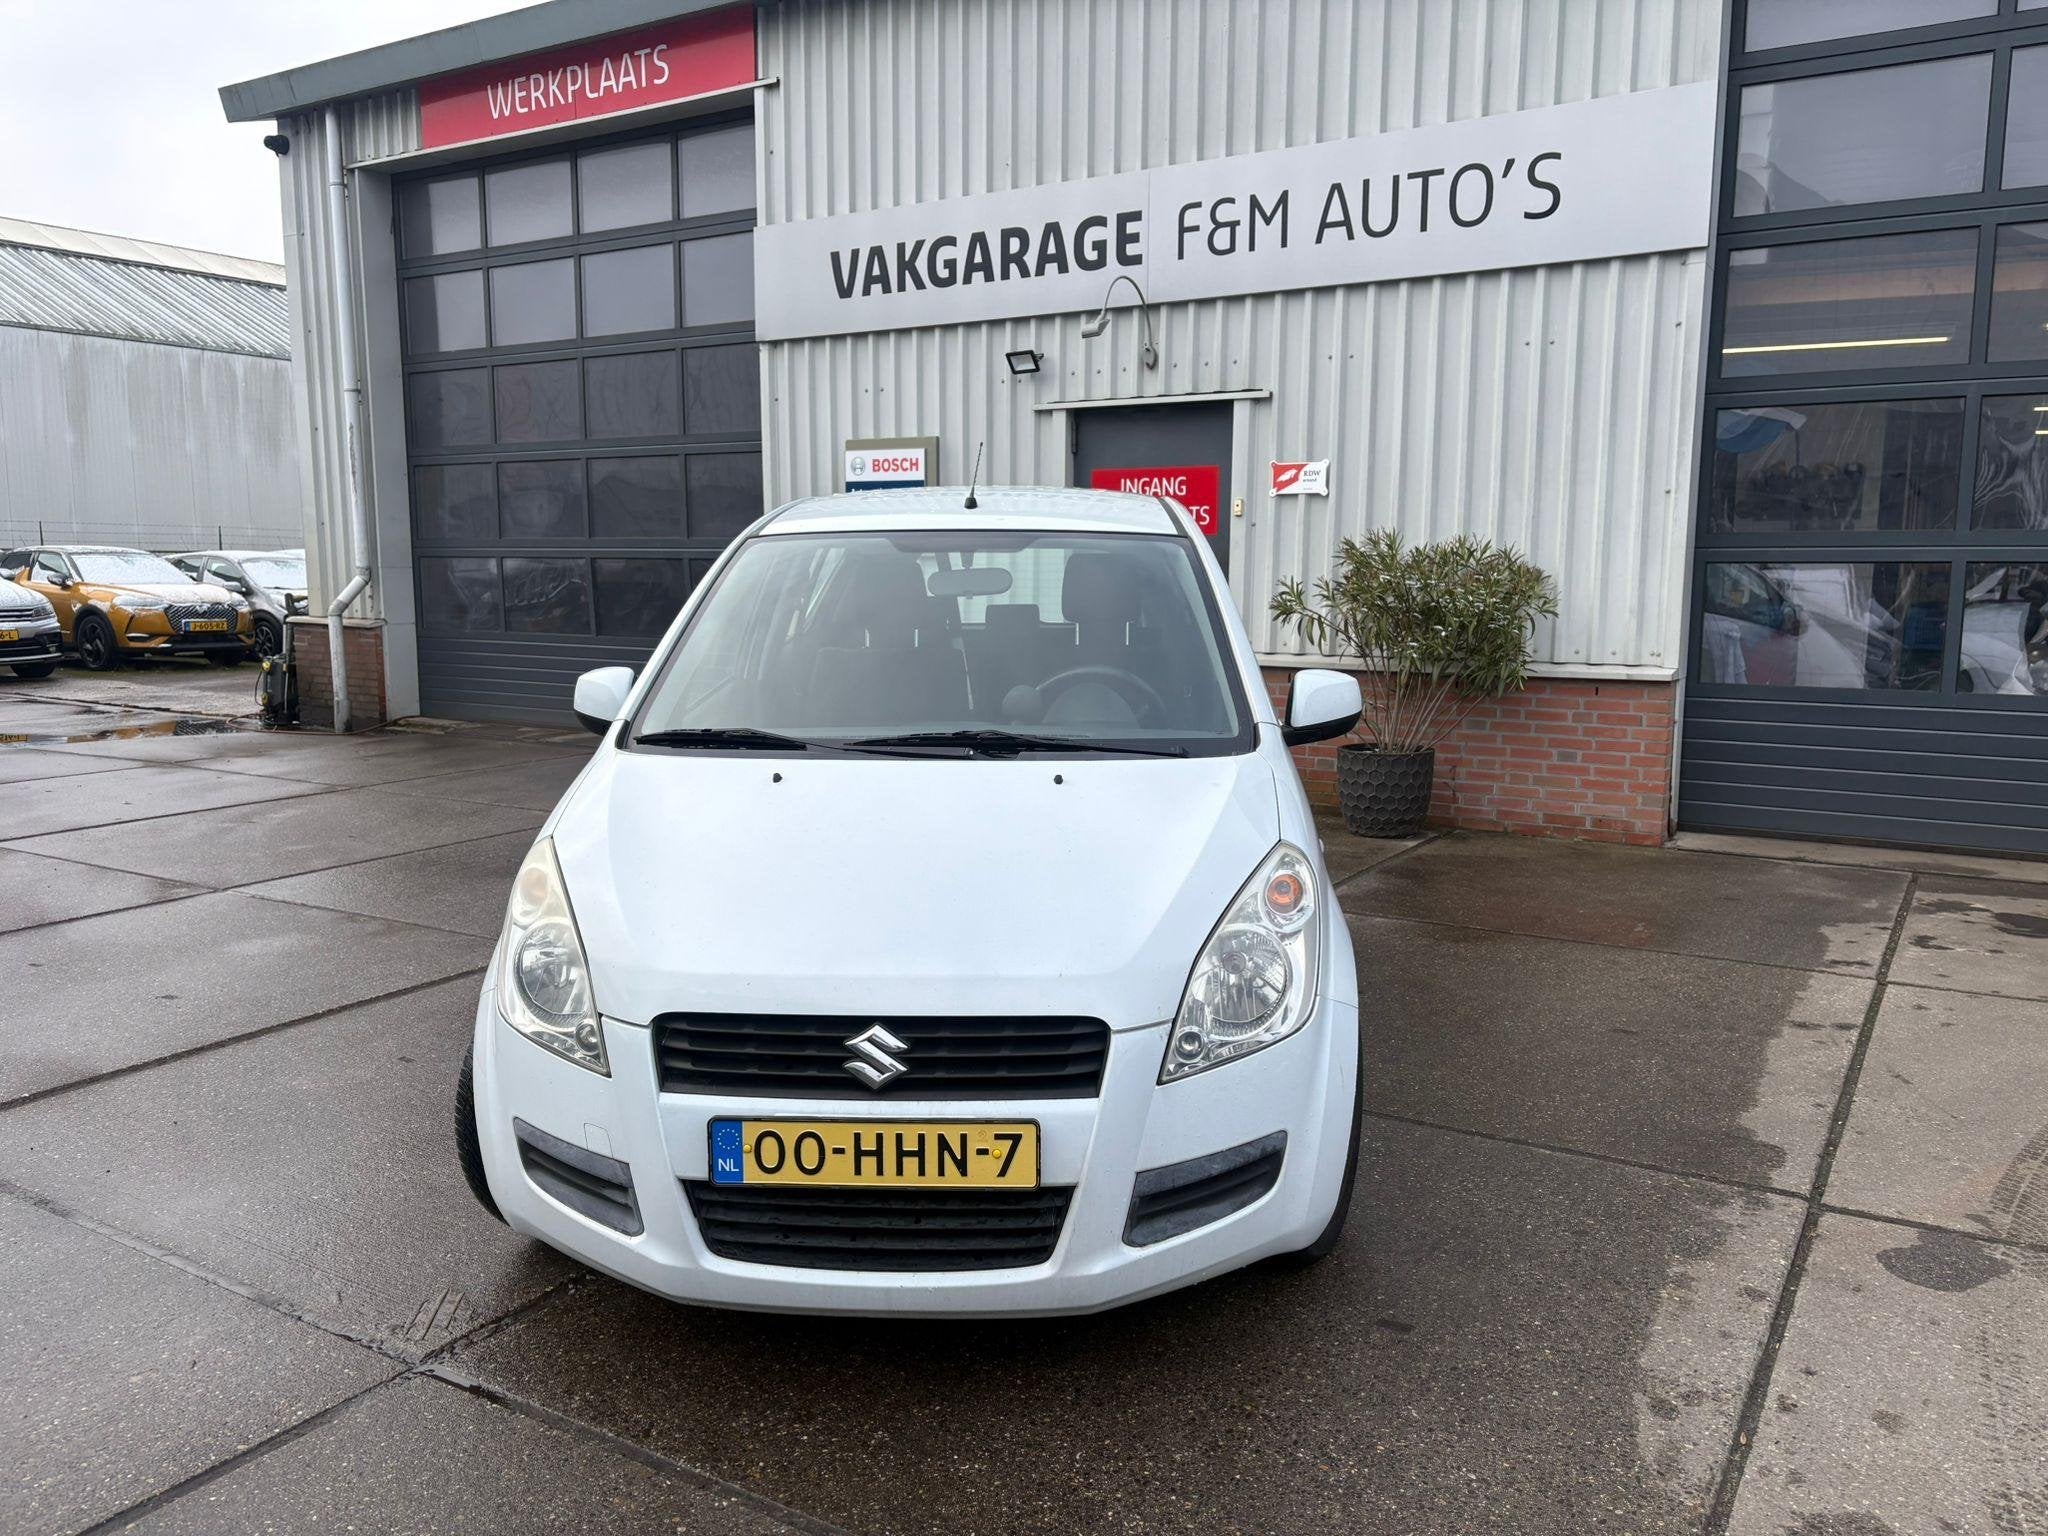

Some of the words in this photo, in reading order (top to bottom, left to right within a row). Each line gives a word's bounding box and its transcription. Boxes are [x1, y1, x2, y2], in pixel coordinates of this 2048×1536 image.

[486, 44, 670, 119] WERKPLAATS
[830, 210, 1143, 299] VAKGARAGE
[1177, 189, 1289, 260] F&M
[872, 458, 919, 472] BOSCH
[1121, 477, 1187, 496] INGANG
[718, 1158, 739, 1171] NL
[753, 1130, 1023, 1177] 00-HHN-7
